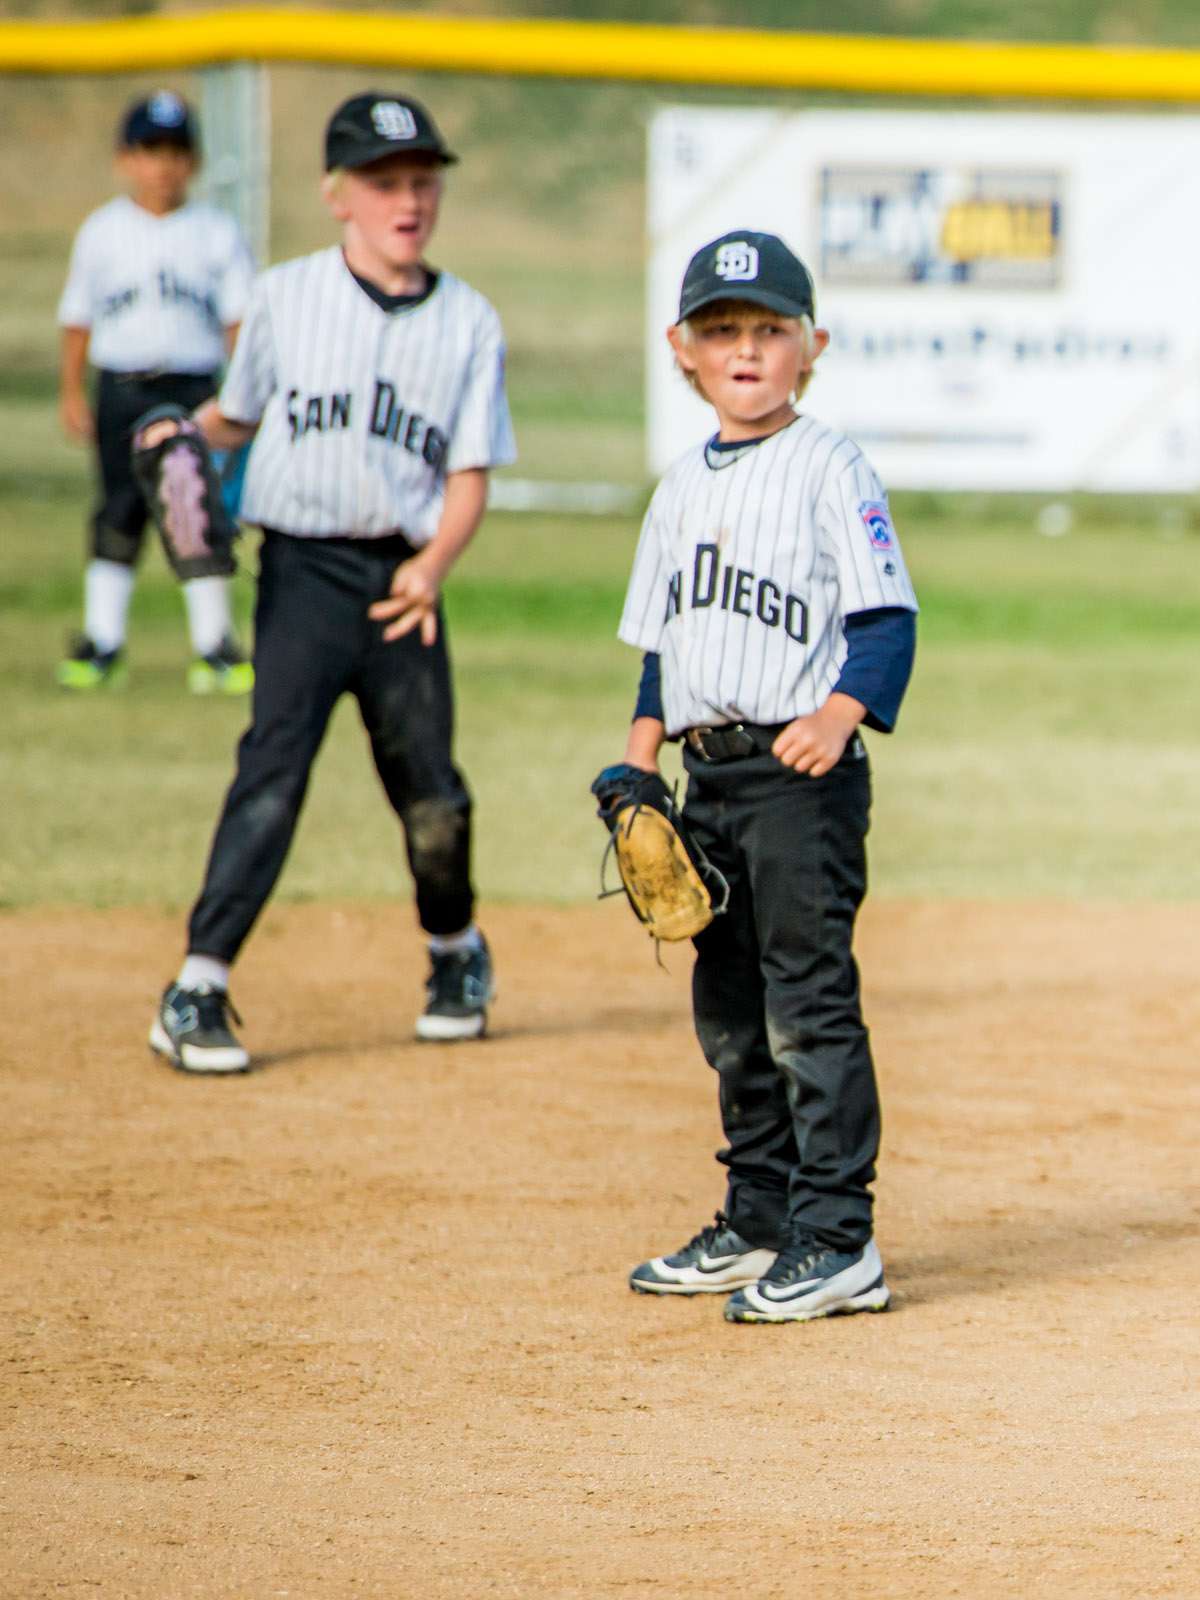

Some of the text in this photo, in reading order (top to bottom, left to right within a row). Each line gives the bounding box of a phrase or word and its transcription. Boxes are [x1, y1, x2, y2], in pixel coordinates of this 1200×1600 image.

[715, 241, 759, 281] SD
[287, 389, 351, 443] SAN
[691, 543, 808, 644] DIEGO
